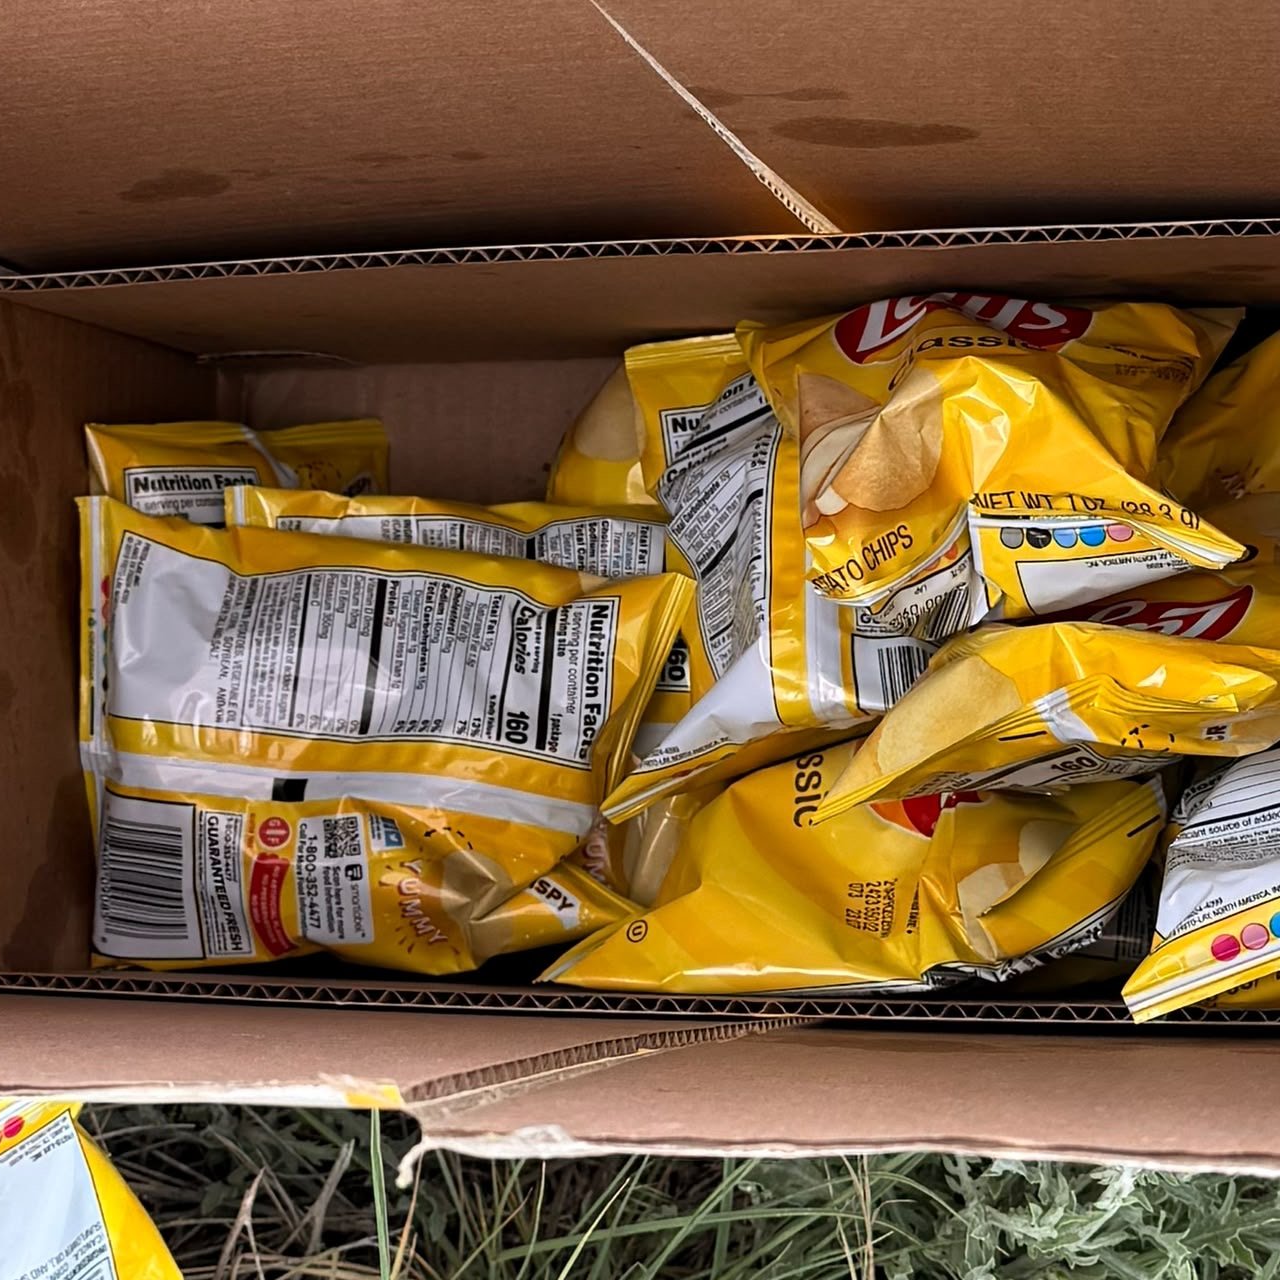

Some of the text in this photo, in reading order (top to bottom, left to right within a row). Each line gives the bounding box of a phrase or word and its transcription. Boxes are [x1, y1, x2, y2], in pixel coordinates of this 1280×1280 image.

[133, 474, 212, 493] Nutrition
[681, 480, 721, 523] Carbohydrate
[696, 509, 713, 526] Fiber
[973, 487, 1015, 510] NET
[1019, 490, 1054, 511] WT
[1067, 493, 1077, 511] 1
[1179, 508, 1201, 530] g)
[700, 498, 739, 541] Sugars less than
[588, 522, 597, 557] Sodium
[637, 525, 649, 564] Total Fat
[693, 545, 716, 569] Protein
[861, 524, 914, 570] CHIPS
[612, 555, 621, 568] Fat
[289, 590, 303, 626] significant
[322, 573, 336, 610] Potassium
[347, 574, 364, 629] Calcium 10mg
[364, 577, 377, 606] Vitamin
[385, 580, 399, 615] Protein
[410, 589, 423, 619] Dietary
[425, 581, 437, 604] Total
[396, 610, 409, 640] Sugars
[431, 582, 450, 643] Sodium 140mg
[445, 586, 463, 635] Cholesterol
[471, 602, 487, 638] Saturated
[482, 594, 501, 651] Total Fat 10g
[285, 627, 299, 654] source
[408, 620, 420, 641] Fiber
[417, 605, 435, 672] Carbohydrate
[512, 606, 535, 674] Calories
[570, 611, 584, 646] serving
[218, 636, 232, 680] SOYBEAN,
[556, 639, 568, 657] size
[569, 649, 581, 665] per
[667, 650, 686, 680] 60
[227, 659, 243, 709] VEGETABLE
[281, 665, 294, 690] added
[565, 668, 579, 714] container
[578, 603, 609, 760] Nutrition Facts
[349, 719, 359, 733] 0%
[469, 717, 481, 737] 13%
[504, 710, 529, 744] 160
[547, 717, 562, 752] package
[1050, 753, 1097, 776] 160
[298, 823, 307, 837] Call
[1208, 819, 1239, 834] source
[1241, 816, 1252, 826] of
[298, 839, 307, 854] For
[204, 815, 233, 909] GUARANTEED
[222, 910, 243, 950] FRESH
[299, 877, 308, 895] Food
[306, 835, 320, 928] 1-800-352-4477
[321, 865, 335, 932] food information
[331, 865, 346, 939] Scan here for more
[397, 859, 447, 945] YUMMY
[1212, 902, 1237, 917] NORTH
[27, 1259, 49, 1279] AND
